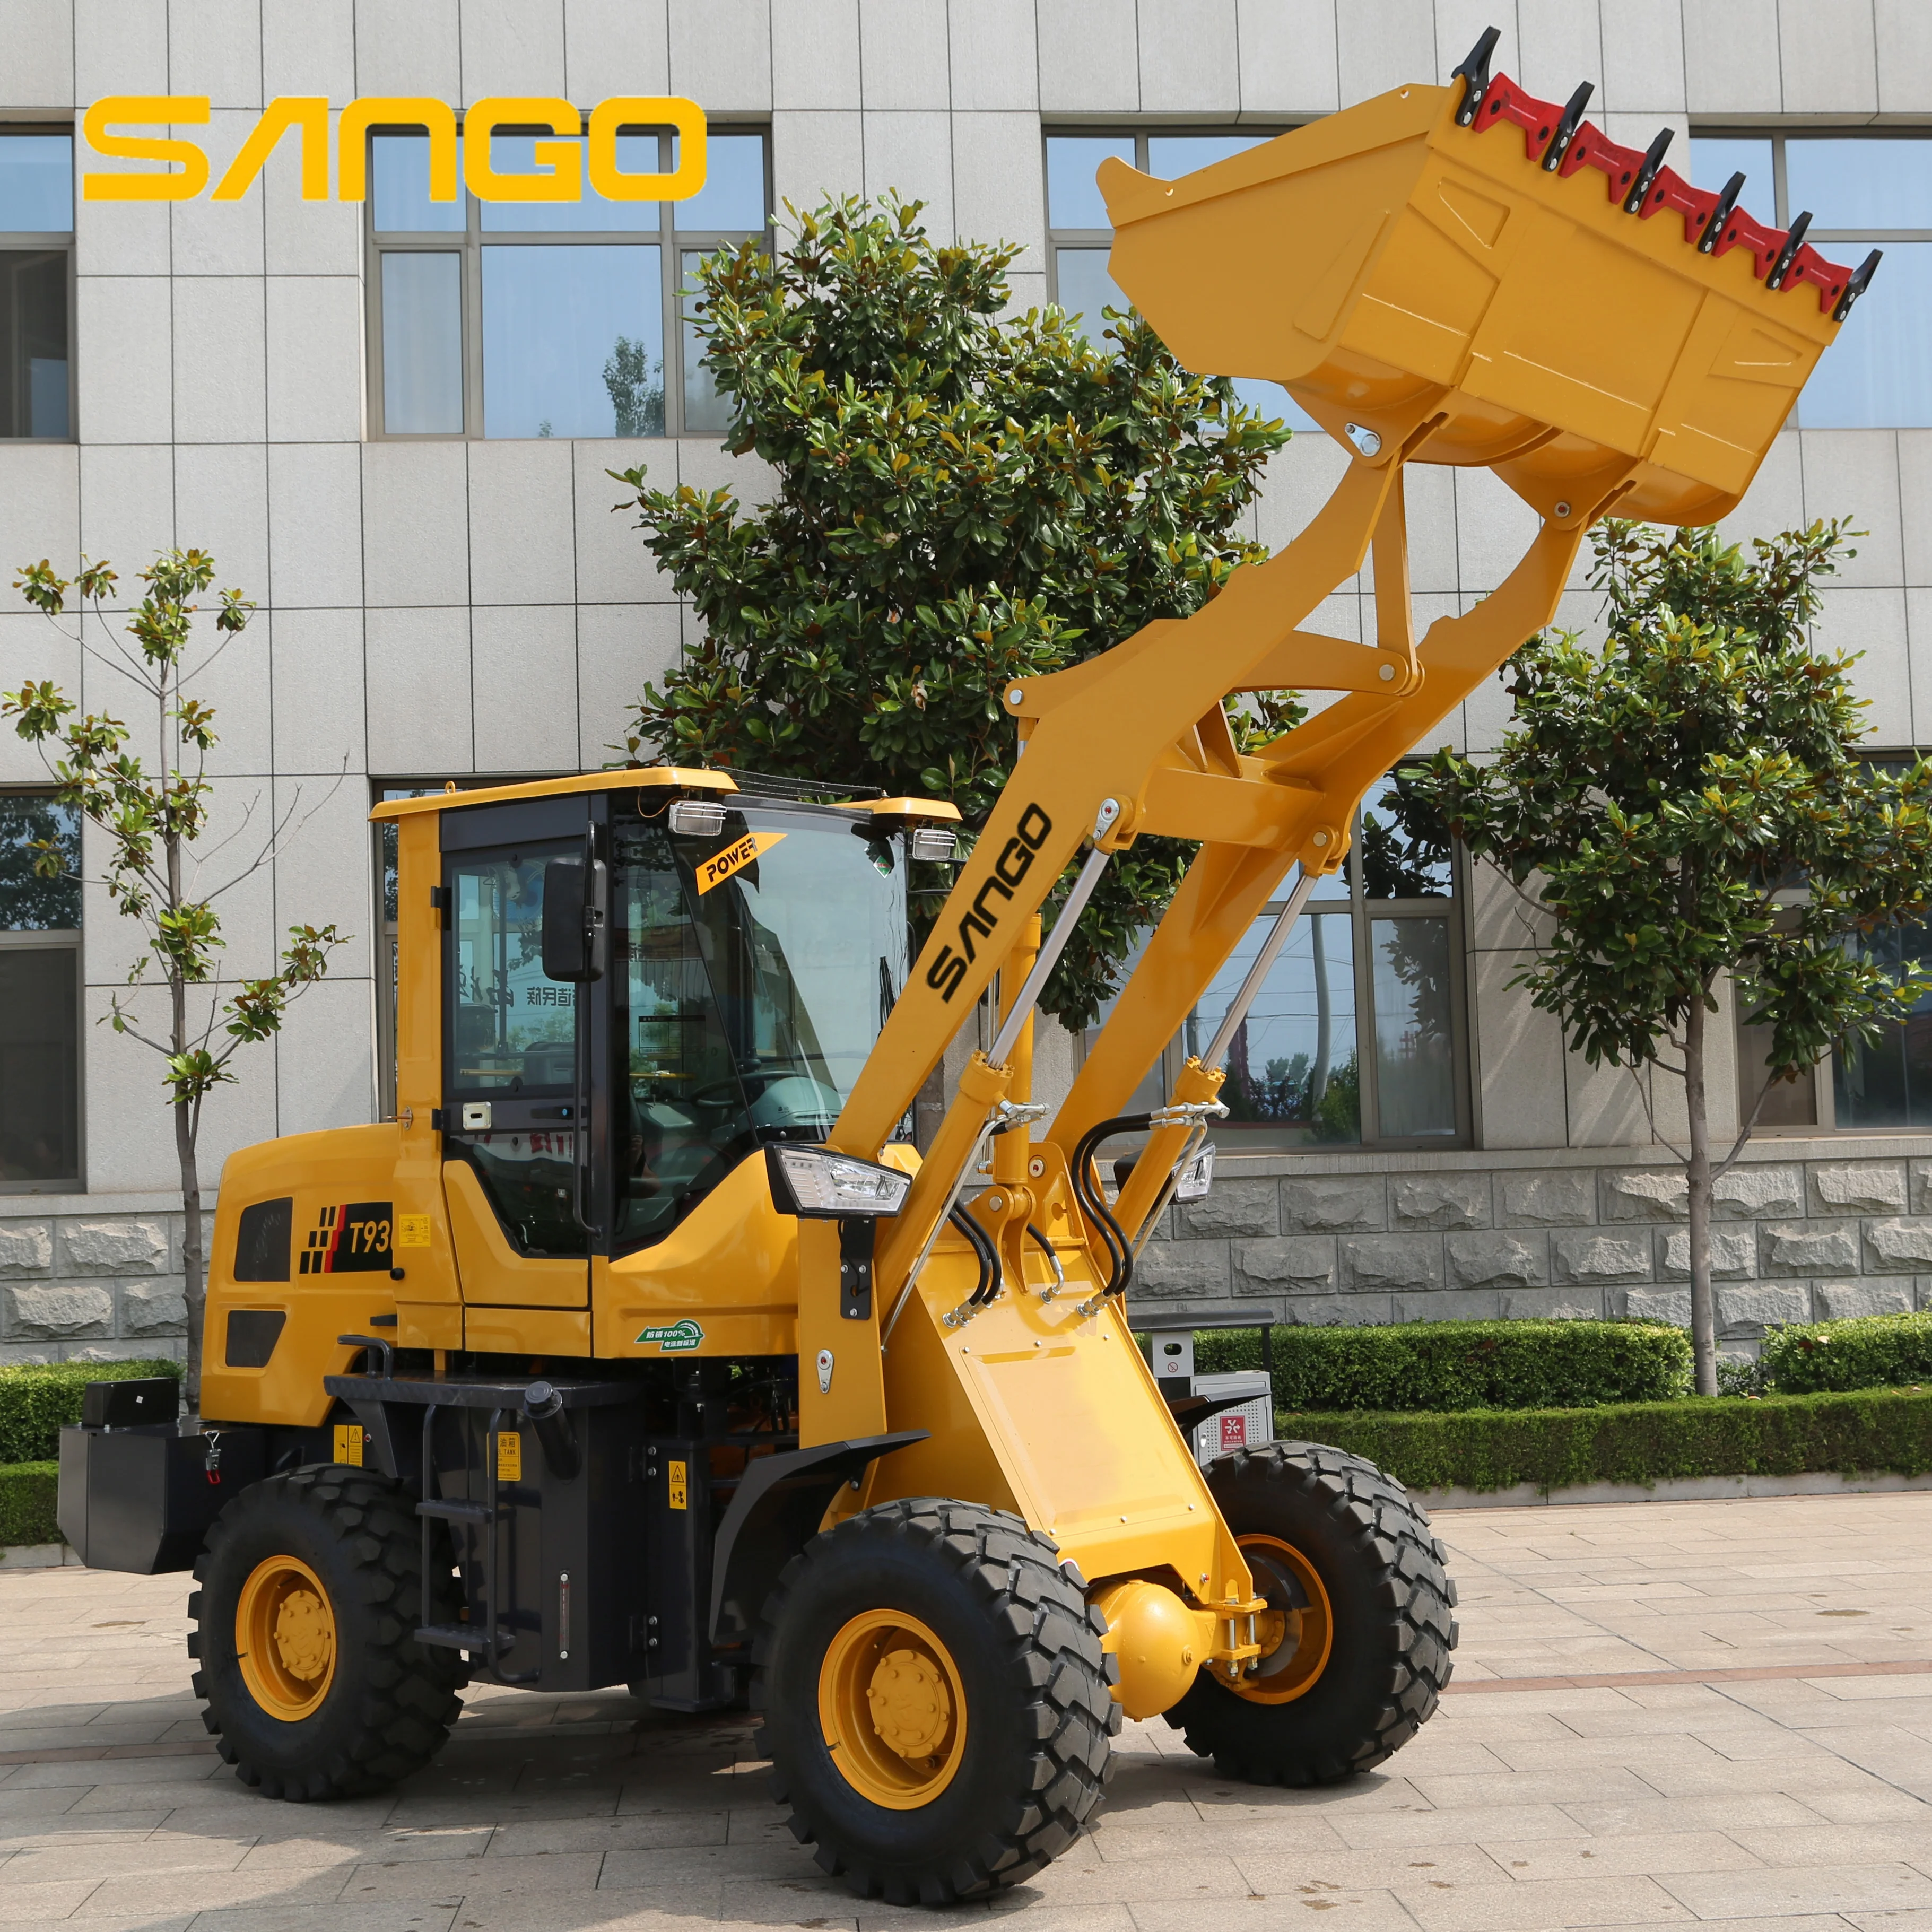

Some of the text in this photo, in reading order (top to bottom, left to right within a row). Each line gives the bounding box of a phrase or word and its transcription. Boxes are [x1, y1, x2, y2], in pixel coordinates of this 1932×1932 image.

[706, 837, 758, 883] POWER
[926, 802, 1052, 1004] SANGO
[350, 1220, 393, 1253] T93
[500, 1437, 516, 1448] 油箱
